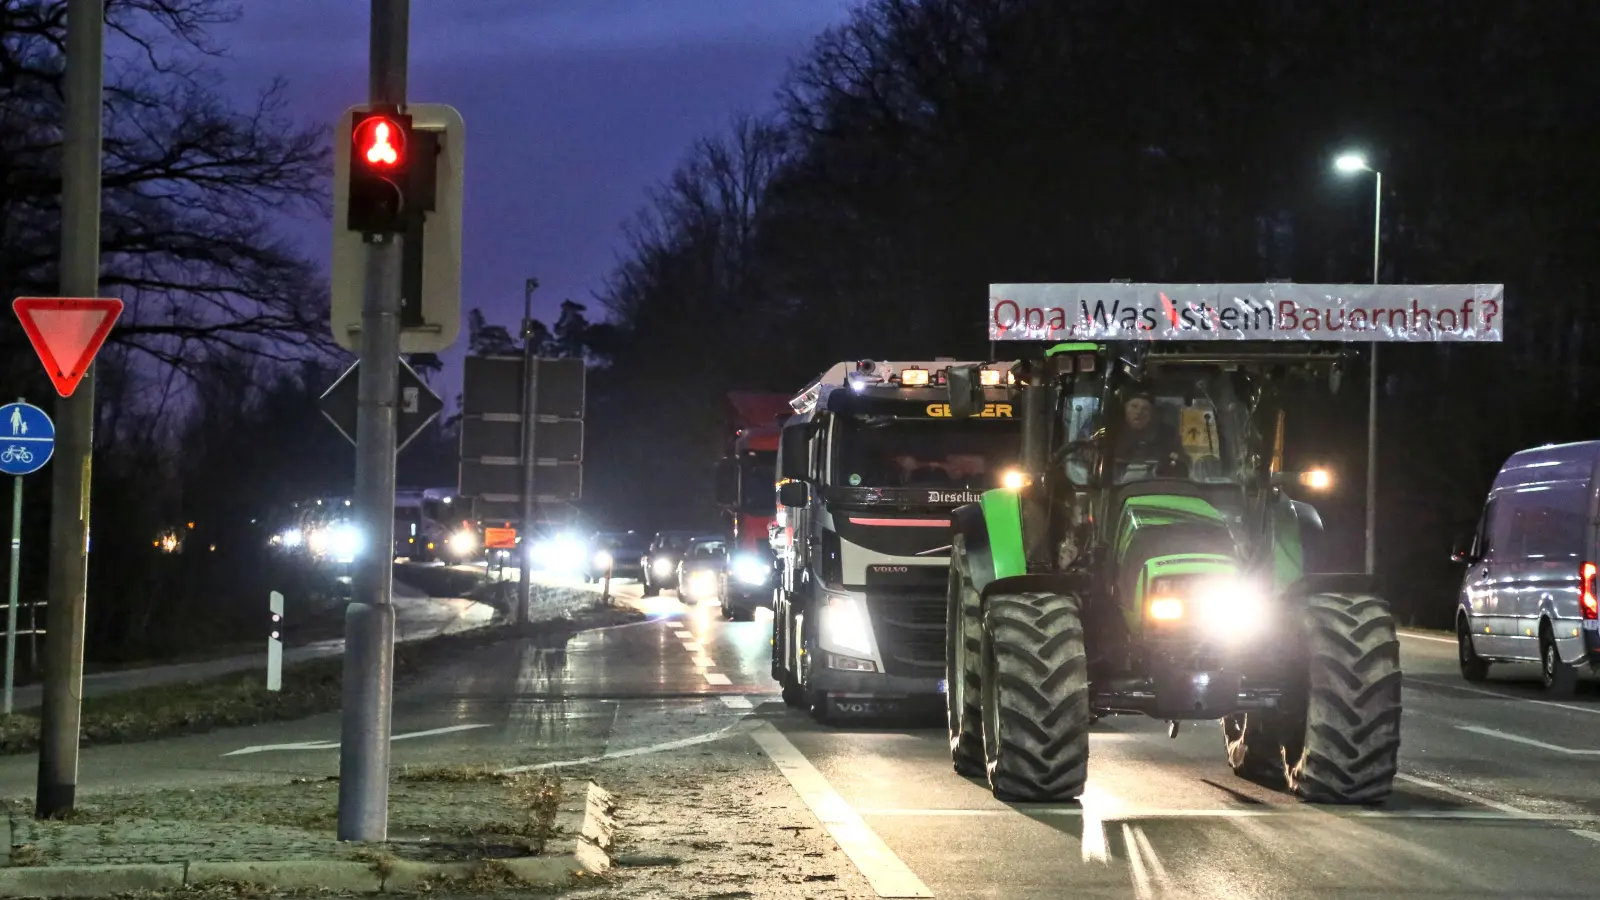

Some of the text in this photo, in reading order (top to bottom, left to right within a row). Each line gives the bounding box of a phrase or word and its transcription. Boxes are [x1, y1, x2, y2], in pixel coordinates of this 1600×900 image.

[1081, 299, 1157, 331] Was
[926, 403, 1013, 418] GEER
[927, 490, 985, 503] Dieselku
